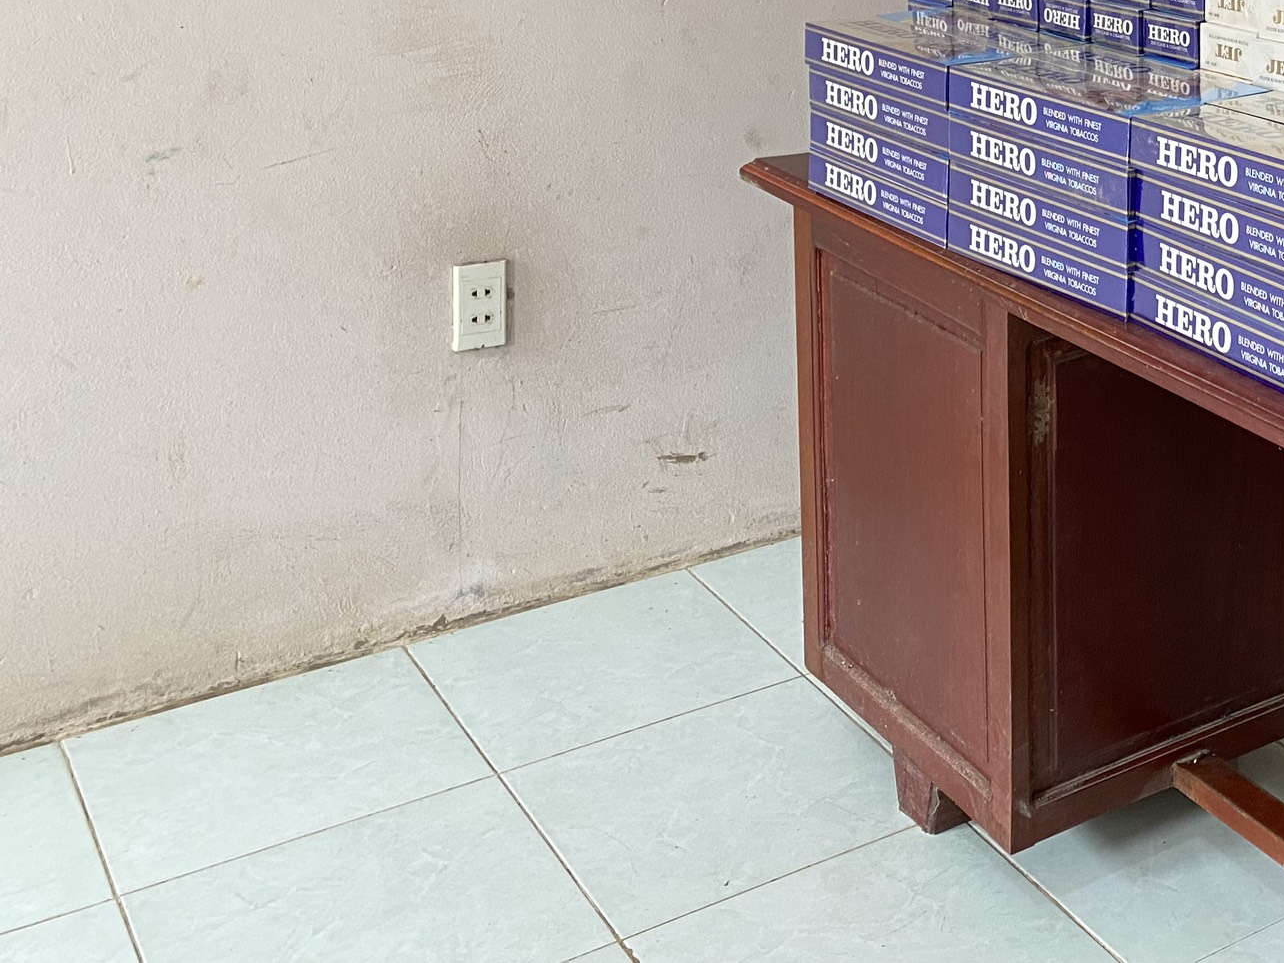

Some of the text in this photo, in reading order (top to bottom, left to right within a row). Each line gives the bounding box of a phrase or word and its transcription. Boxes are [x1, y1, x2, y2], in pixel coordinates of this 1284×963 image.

[1044, 8, 1080, 31] HERO
[1094, 13, 1134, 36] HERO
[1148, 23, 1191, 47] HERO
[822, 38, 874, 76] HERO
[825, 80, 878, 120] HERO
[970, 82, 1037, 126] HERO
[1067, 113, 1081, 125] WITH
[826, 122, 878, 163] HERO
[970, 131, 1036, 176] HERO
[1156, 136, 1238, 188] HERO
[825, 163, 876, 205] HERO
[1245, 167, 1274, 183] BLENDED
[1248, 181, 1276, 198] VIRGINIA
[970, 179, 1037, 226] HERO
[1160, 190, 1240, 245] HERO
[969, 225, 1036, 273] HERO
[1159, 243, 1234, 301] HERO
[1155, 294, 1232, 354] HERO
